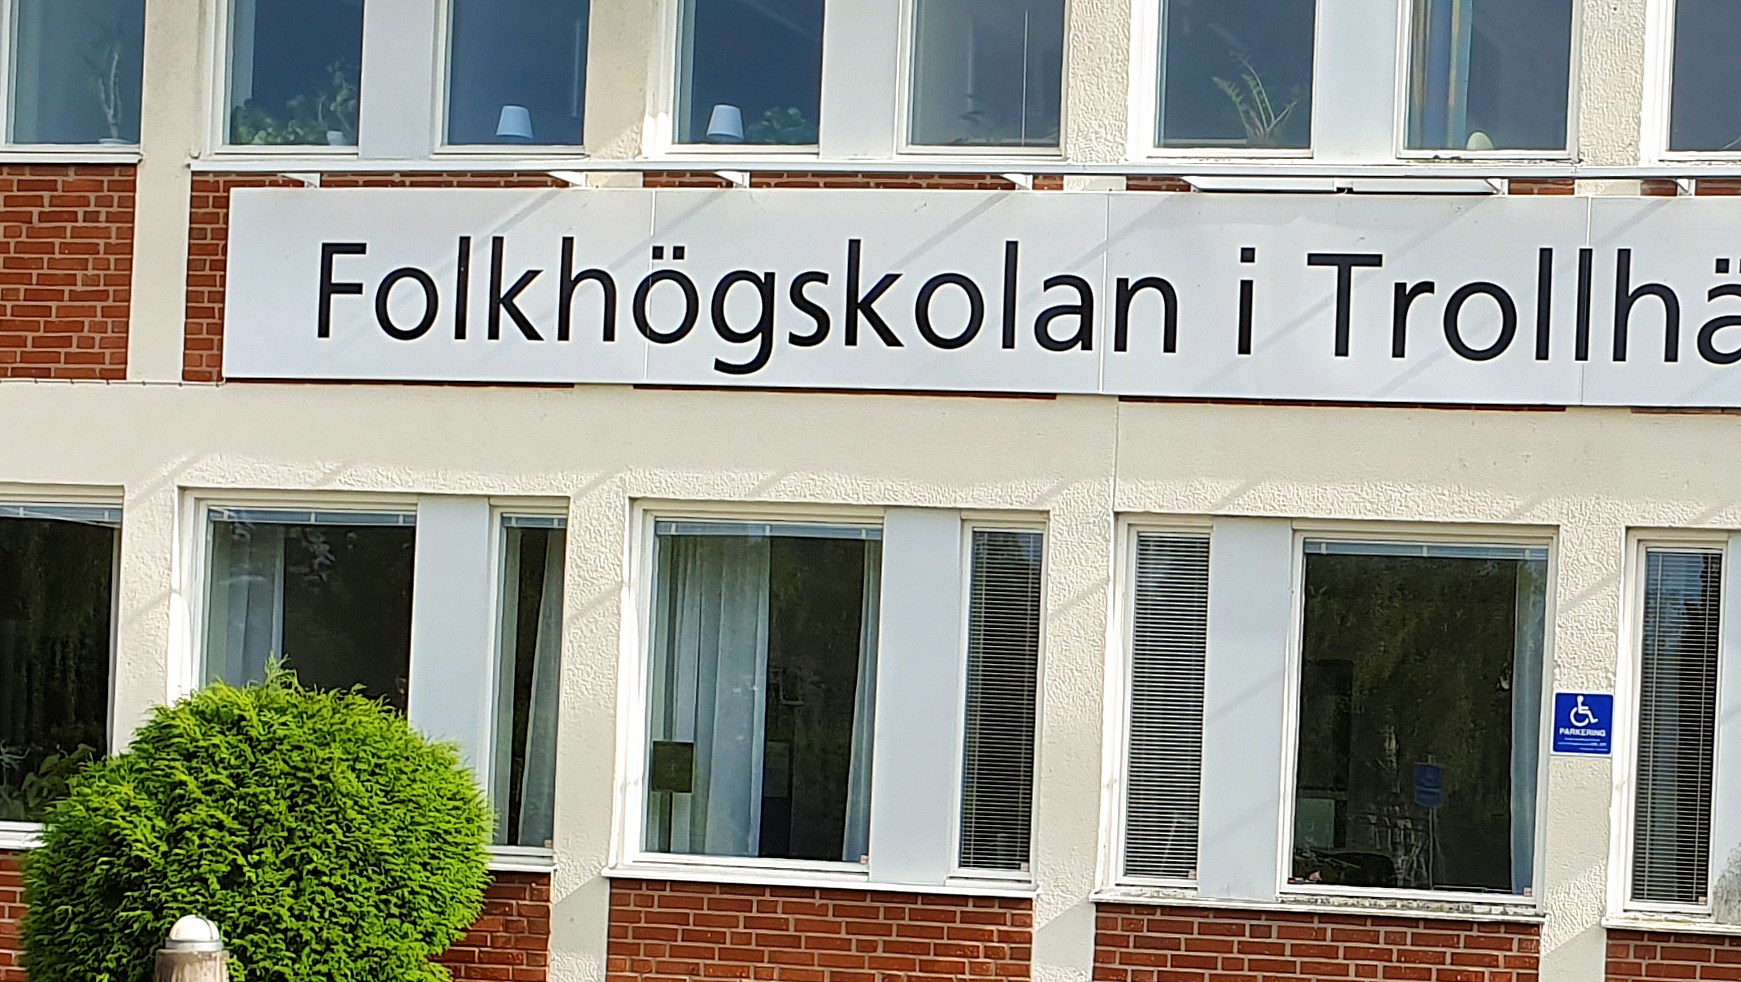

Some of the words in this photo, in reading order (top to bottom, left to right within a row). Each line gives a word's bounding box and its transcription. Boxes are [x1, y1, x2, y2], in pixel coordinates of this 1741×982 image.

[316, 236, 1179, 375] Folkhögskolan
[1237, 247, 1256, 356] i
[1559, 727, 1606, 737] PARKERING
